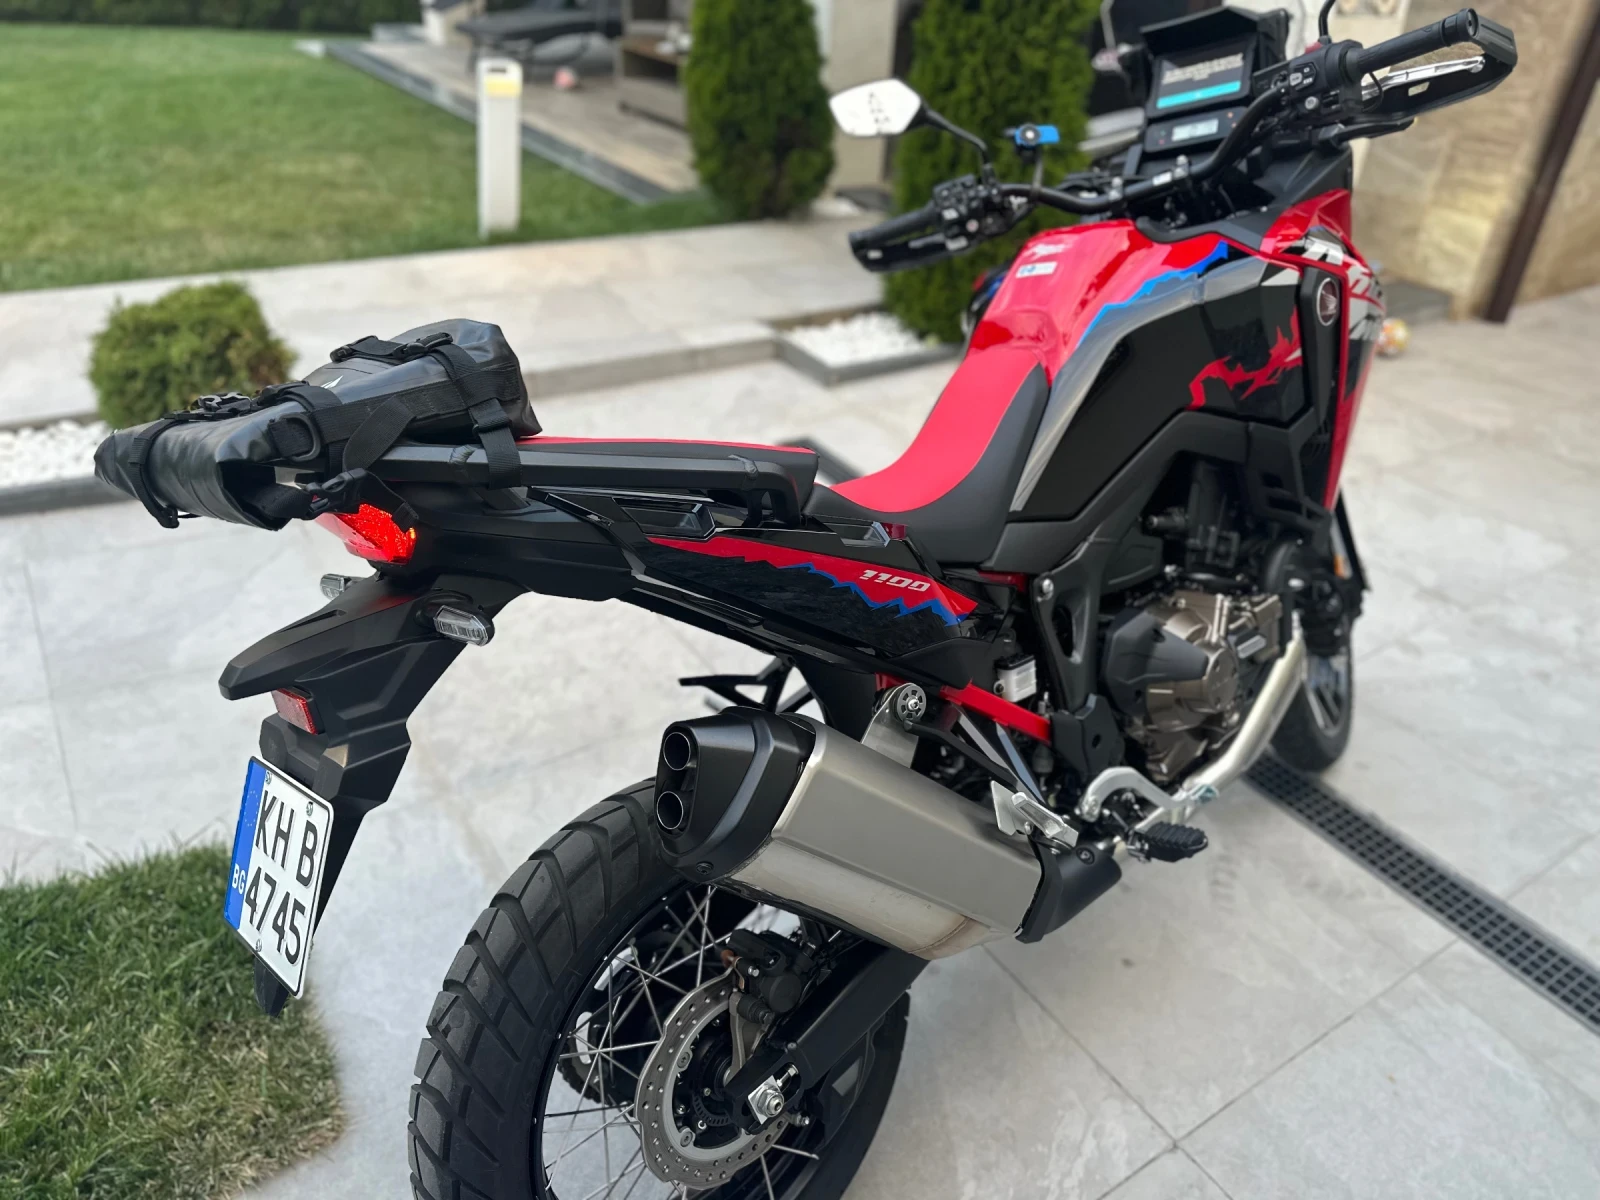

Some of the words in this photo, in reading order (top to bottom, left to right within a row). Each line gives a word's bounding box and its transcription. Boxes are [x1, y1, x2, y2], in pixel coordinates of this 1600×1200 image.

[859, 569, 931, 592] 1100
[255, 790, 295, 871] KH
[296, 819, 318, 888] B
[232, 863, 245, 895] BG
[245, 866, 306, 966] 4745
